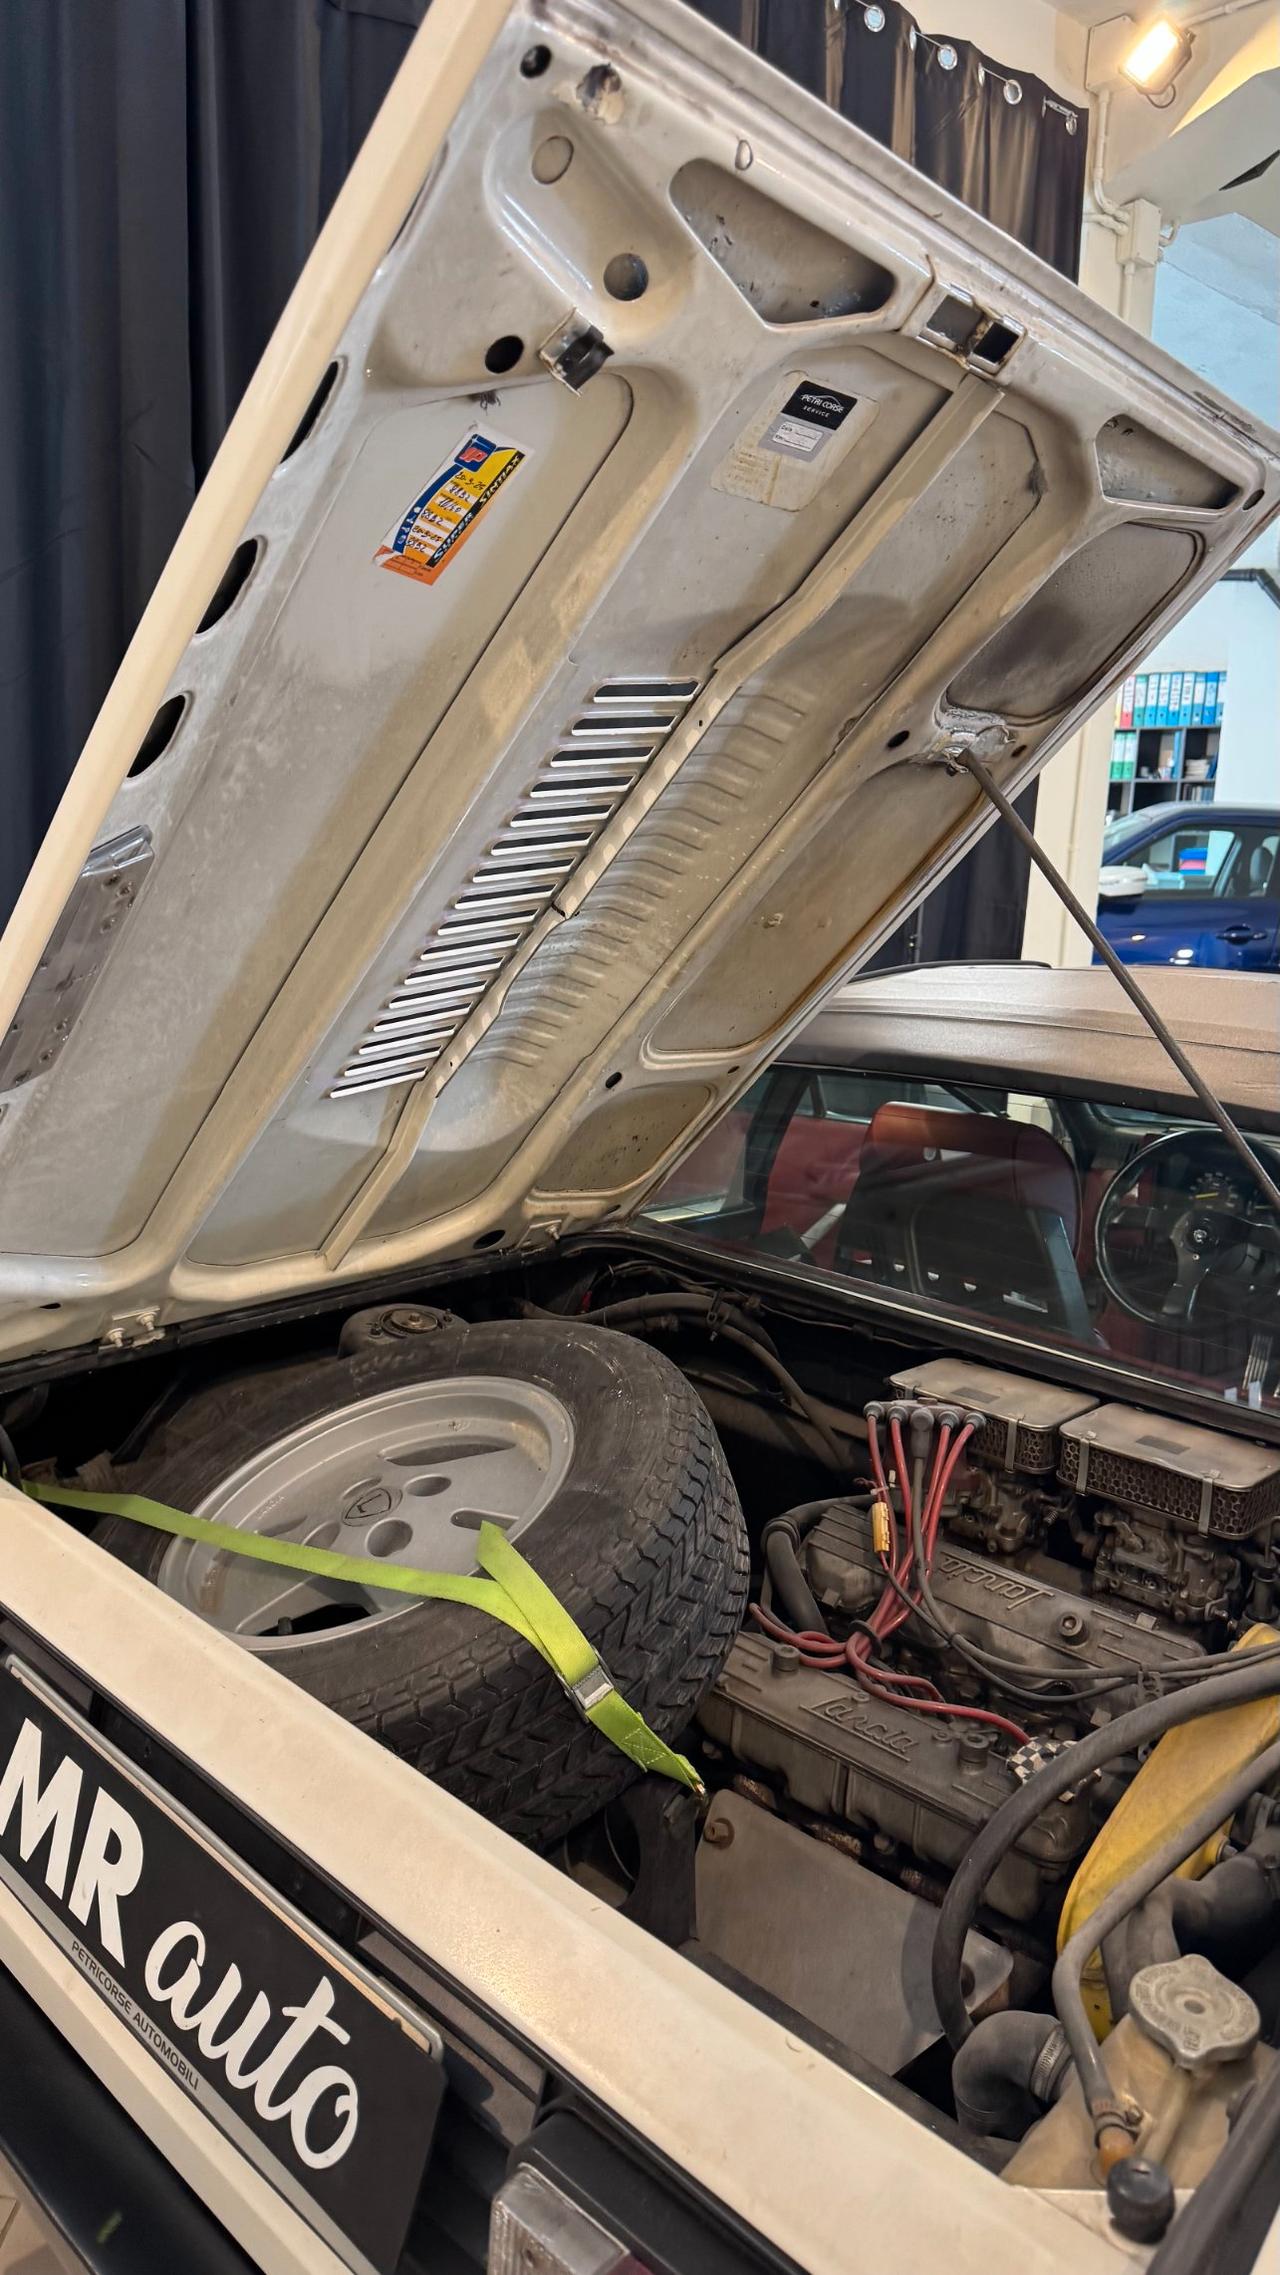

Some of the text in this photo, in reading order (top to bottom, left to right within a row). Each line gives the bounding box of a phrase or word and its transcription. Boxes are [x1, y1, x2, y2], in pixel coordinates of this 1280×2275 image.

[801, 394, 845, 414] PETRI CORSE
[803, 405, 830, 418] SERVICE
[0, 1718, 358, 2170] MR auto
[71, 1941, 199, 2090] PETRICORSE AUTOMOBILI
